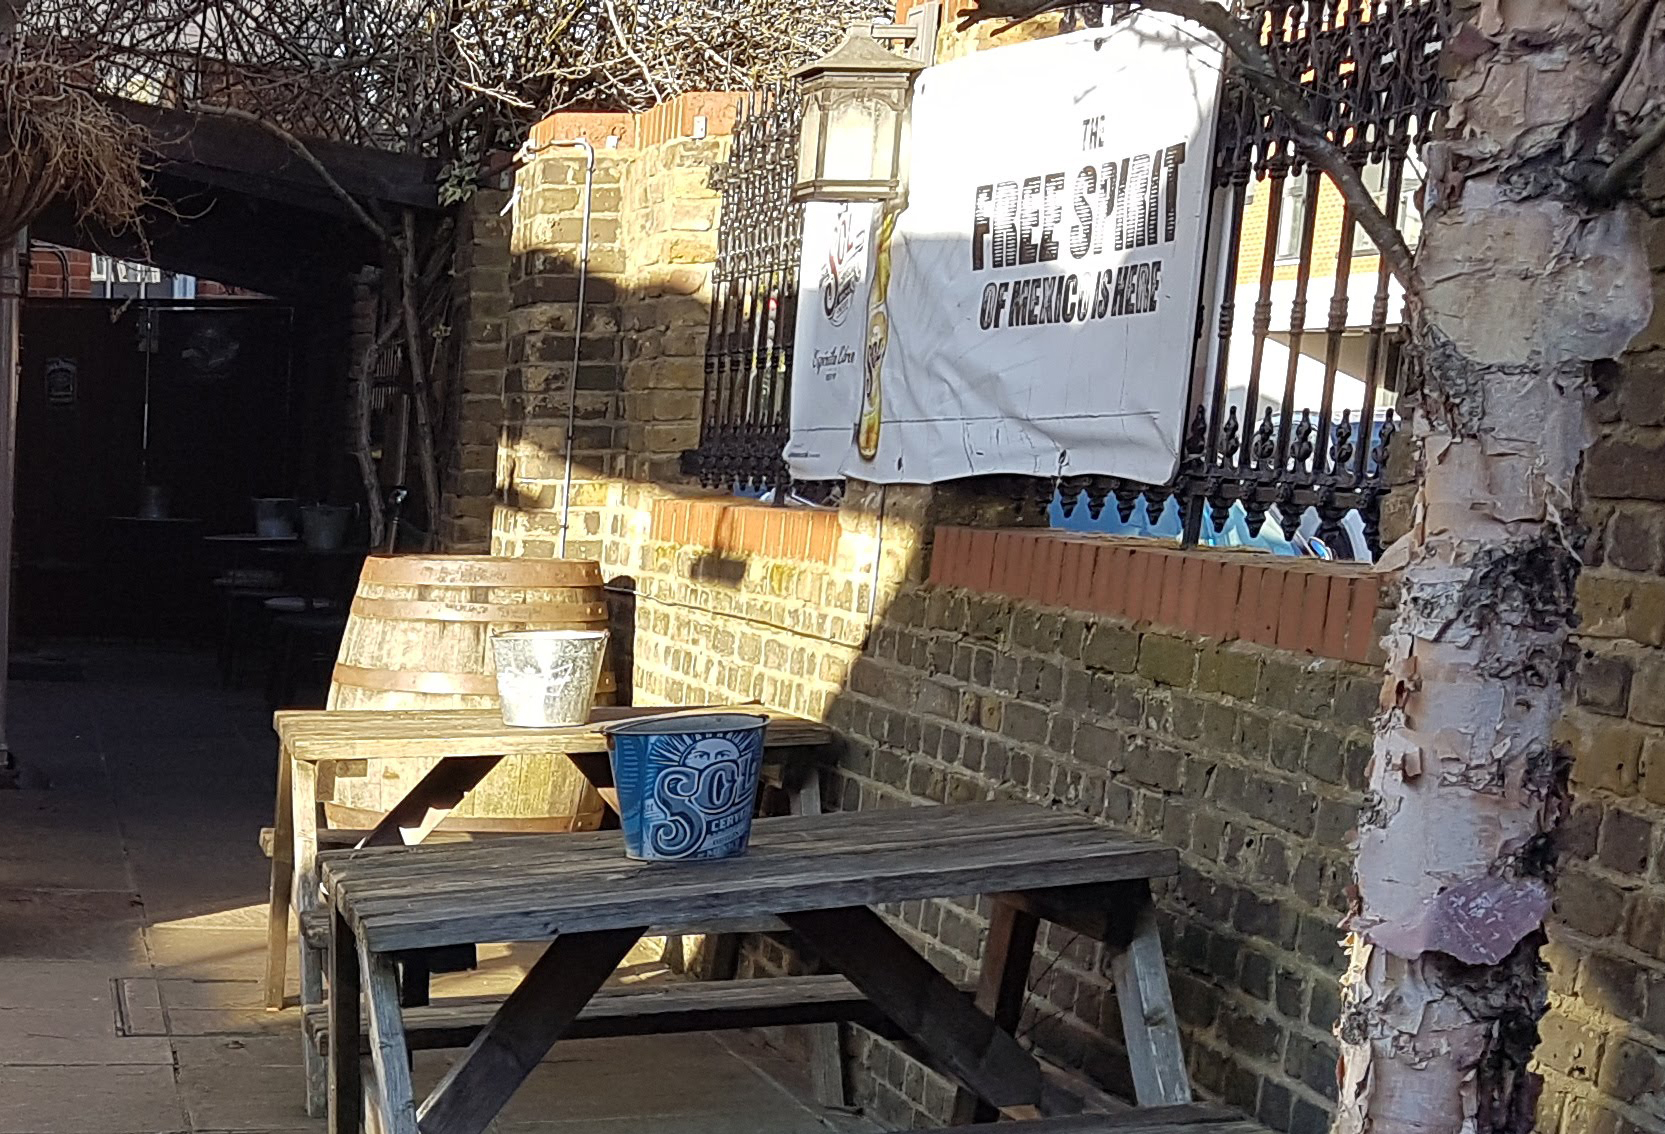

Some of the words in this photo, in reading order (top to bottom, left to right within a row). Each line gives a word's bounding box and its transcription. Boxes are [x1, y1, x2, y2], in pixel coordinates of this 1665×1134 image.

[1083, 115, 1105, 151] THE
[972, 172, 1065, 271] FREE
[1070, 142, 1186, 259] SPIRIT
[980, 282, 1009, 330] OF
[1008, 271, 1091, 327] MEXICO
[1091, 268, 1113, 320] IS
[1111, 260, 1162, 317] HERE
